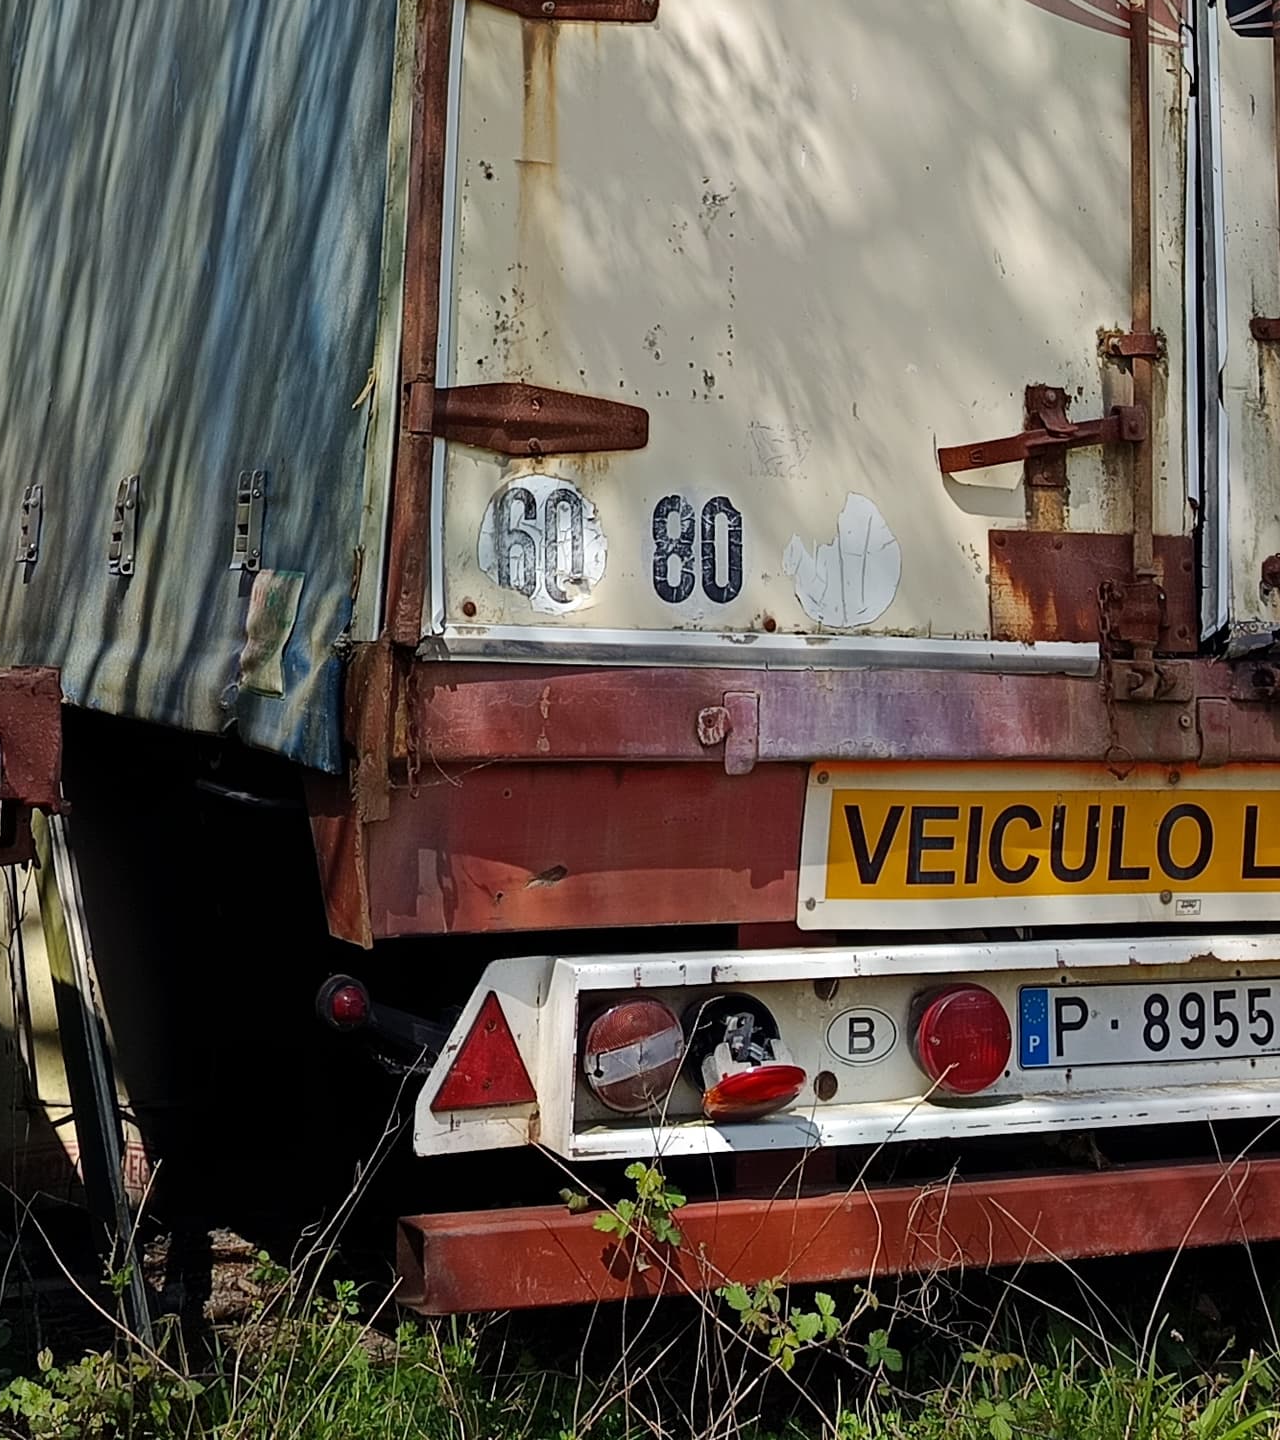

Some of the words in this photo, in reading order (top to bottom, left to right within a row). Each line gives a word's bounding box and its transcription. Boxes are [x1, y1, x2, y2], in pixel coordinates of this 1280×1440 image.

[652, 494, 743, 604] 80
[843, 802, 1214, 885] VEICULO
[848, 1016, 876, 1055] B
[1029, 1035, 1041, 1053] P
[1054, 996, 1089, 1058] P
